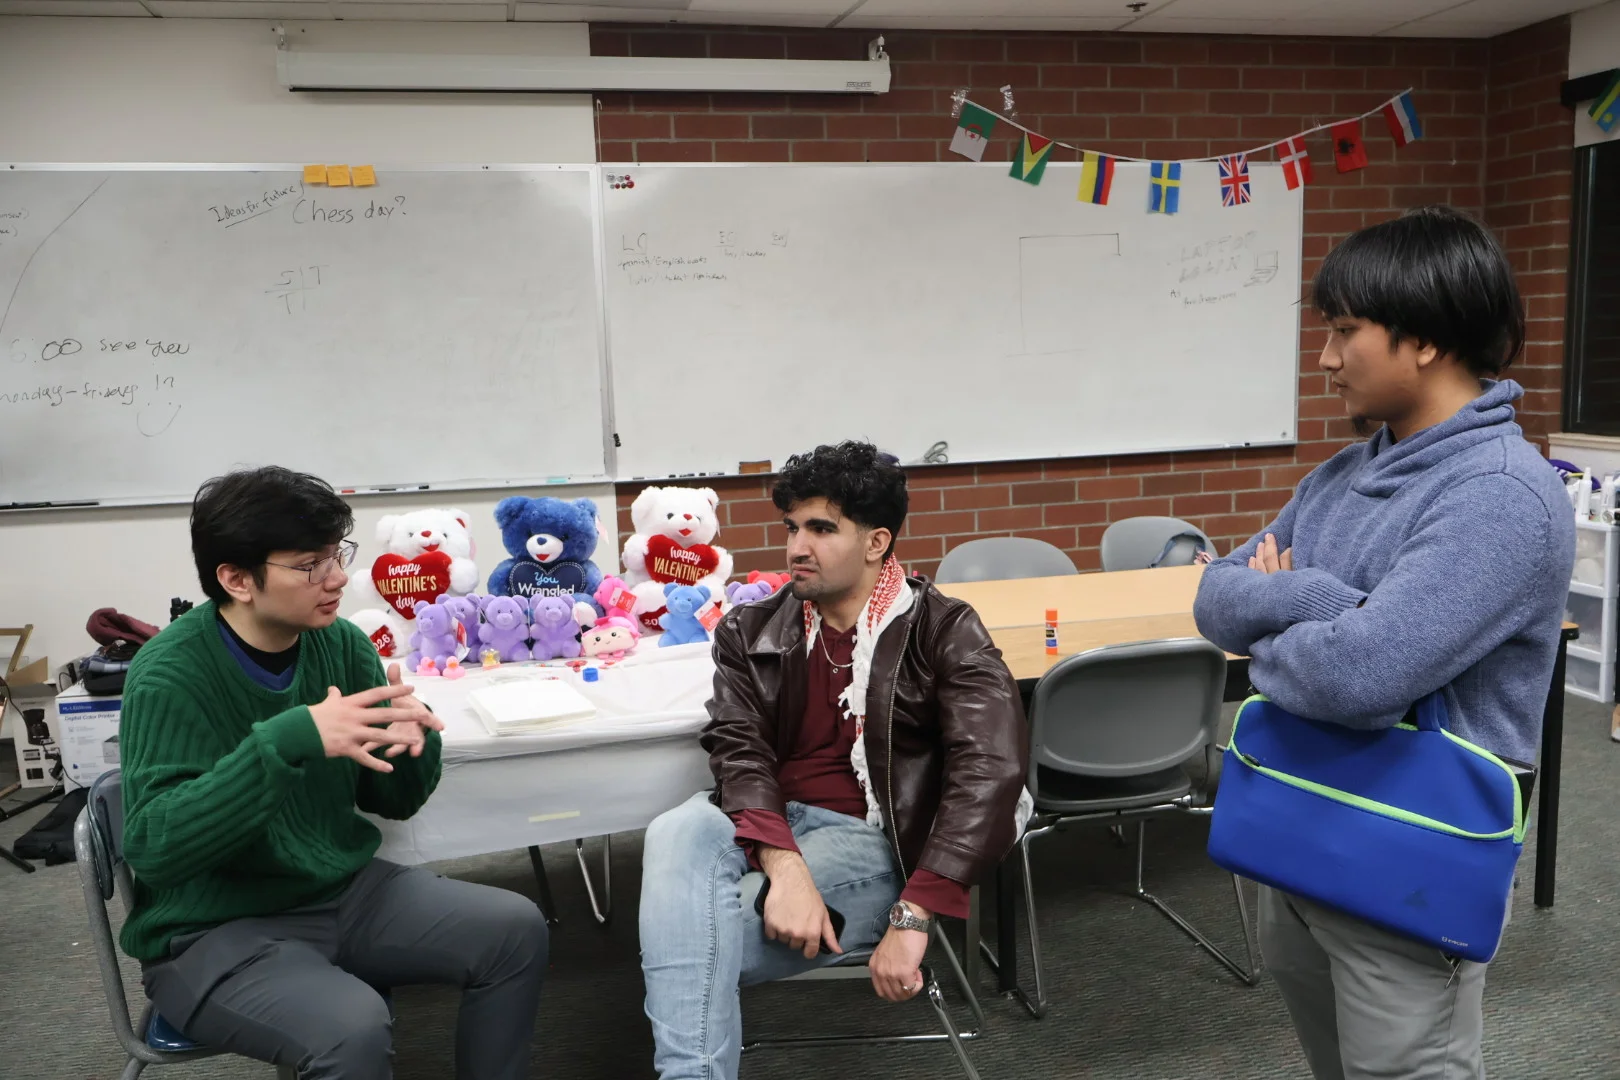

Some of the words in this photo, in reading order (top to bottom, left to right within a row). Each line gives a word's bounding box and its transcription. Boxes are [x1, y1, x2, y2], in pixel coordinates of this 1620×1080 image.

[292, 198, 354, 224] Chess
[364, 195, 407, 223] day?
[99, 338, 137, 352] see
[670, 546, 702, 565] happy
[388, 562, 422, 576] happy
[377, 575, 437, 596] VALENTINE'S
[534, 571, 559, 586] You
[518, 583, 575, 597] Wrangled
[395, 595, 416, 610] day
[644, 618, 658, 626] 20
